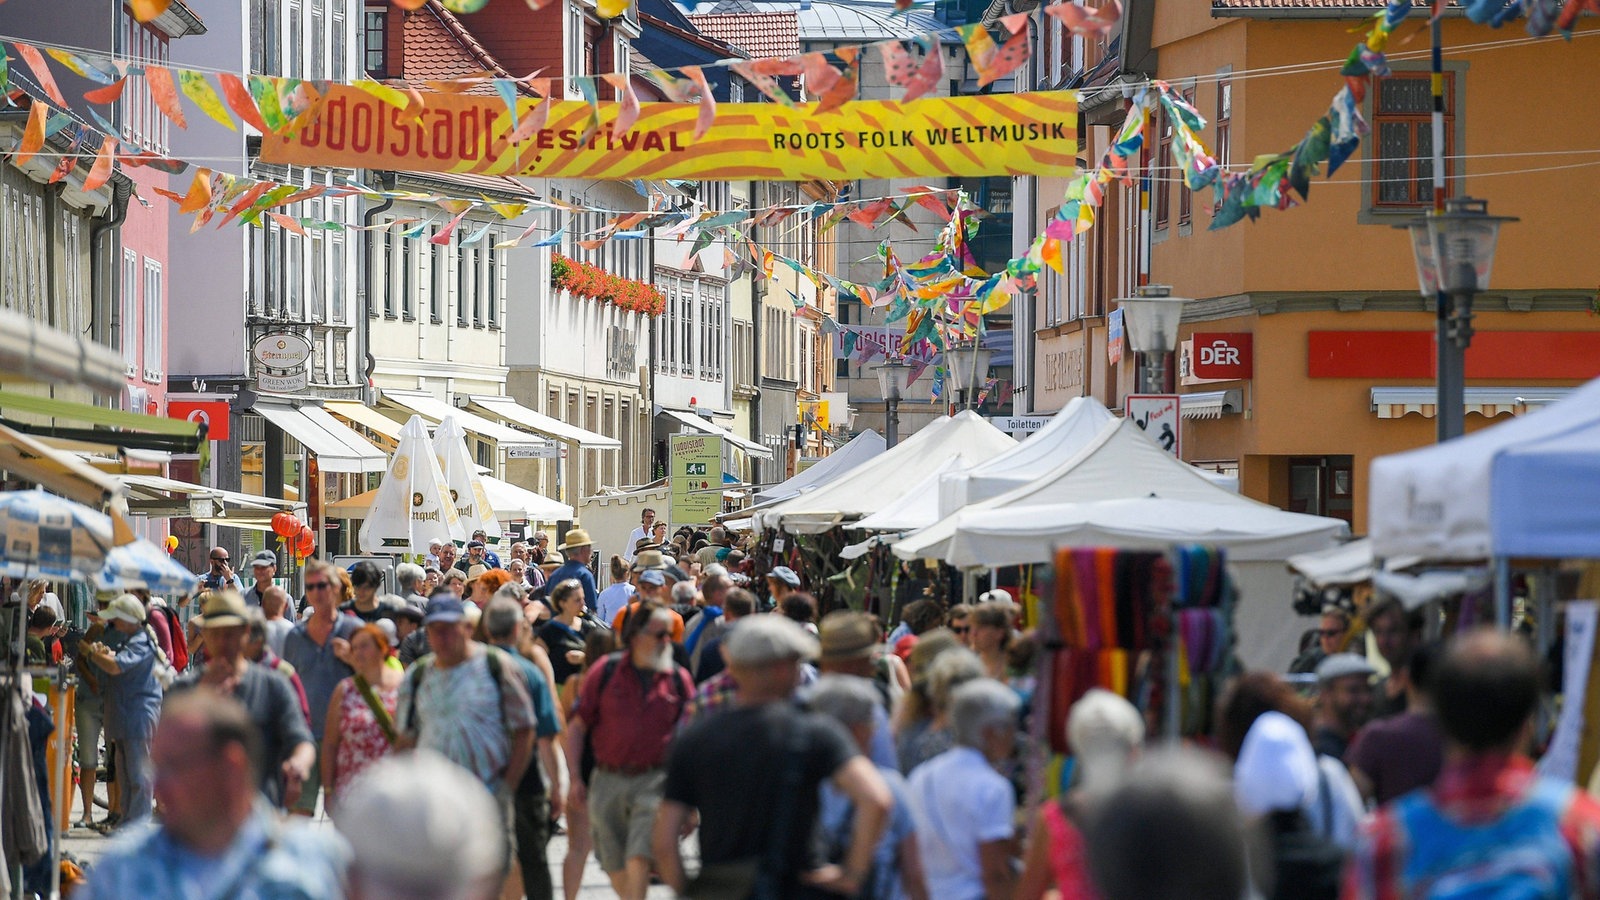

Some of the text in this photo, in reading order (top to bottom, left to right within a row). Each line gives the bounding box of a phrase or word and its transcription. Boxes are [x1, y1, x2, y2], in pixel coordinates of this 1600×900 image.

[283, 96, 500, 163] udolstadt
[773, 122, 1066, 150] ROOTS FOLK WELTMUSIK
[1200, 346, 1241, 365] DER
[287, 377, 303, 385] WOK
[1007, 419, 1041, 429] Toiletten
